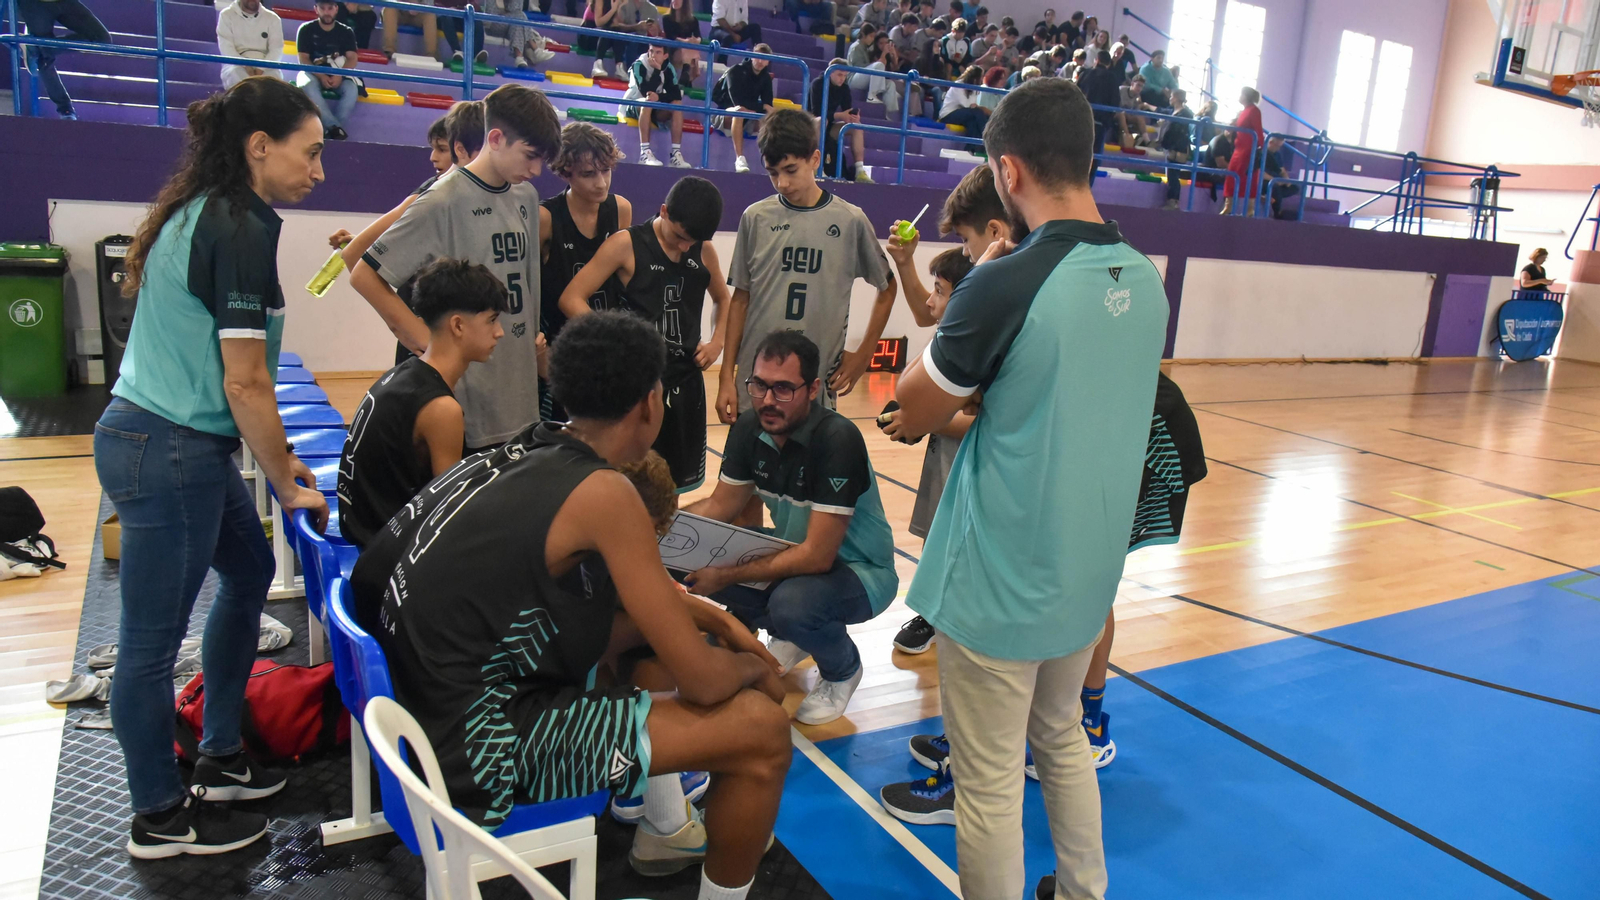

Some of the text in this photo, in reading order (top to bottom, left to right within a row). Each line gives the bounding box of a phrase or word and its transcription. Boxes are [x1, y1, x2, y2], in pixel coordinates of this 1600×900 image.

[472, 207, 493, 217] vive
[770, 223, 791, 233] vive
[491, 232, 526, 264] SEV
[781, 246, 823, 274] SEV
[507, 273, 523, 315] 5
[785, 282, 807, 321] 6
[870, 339, 899, 368] 24
